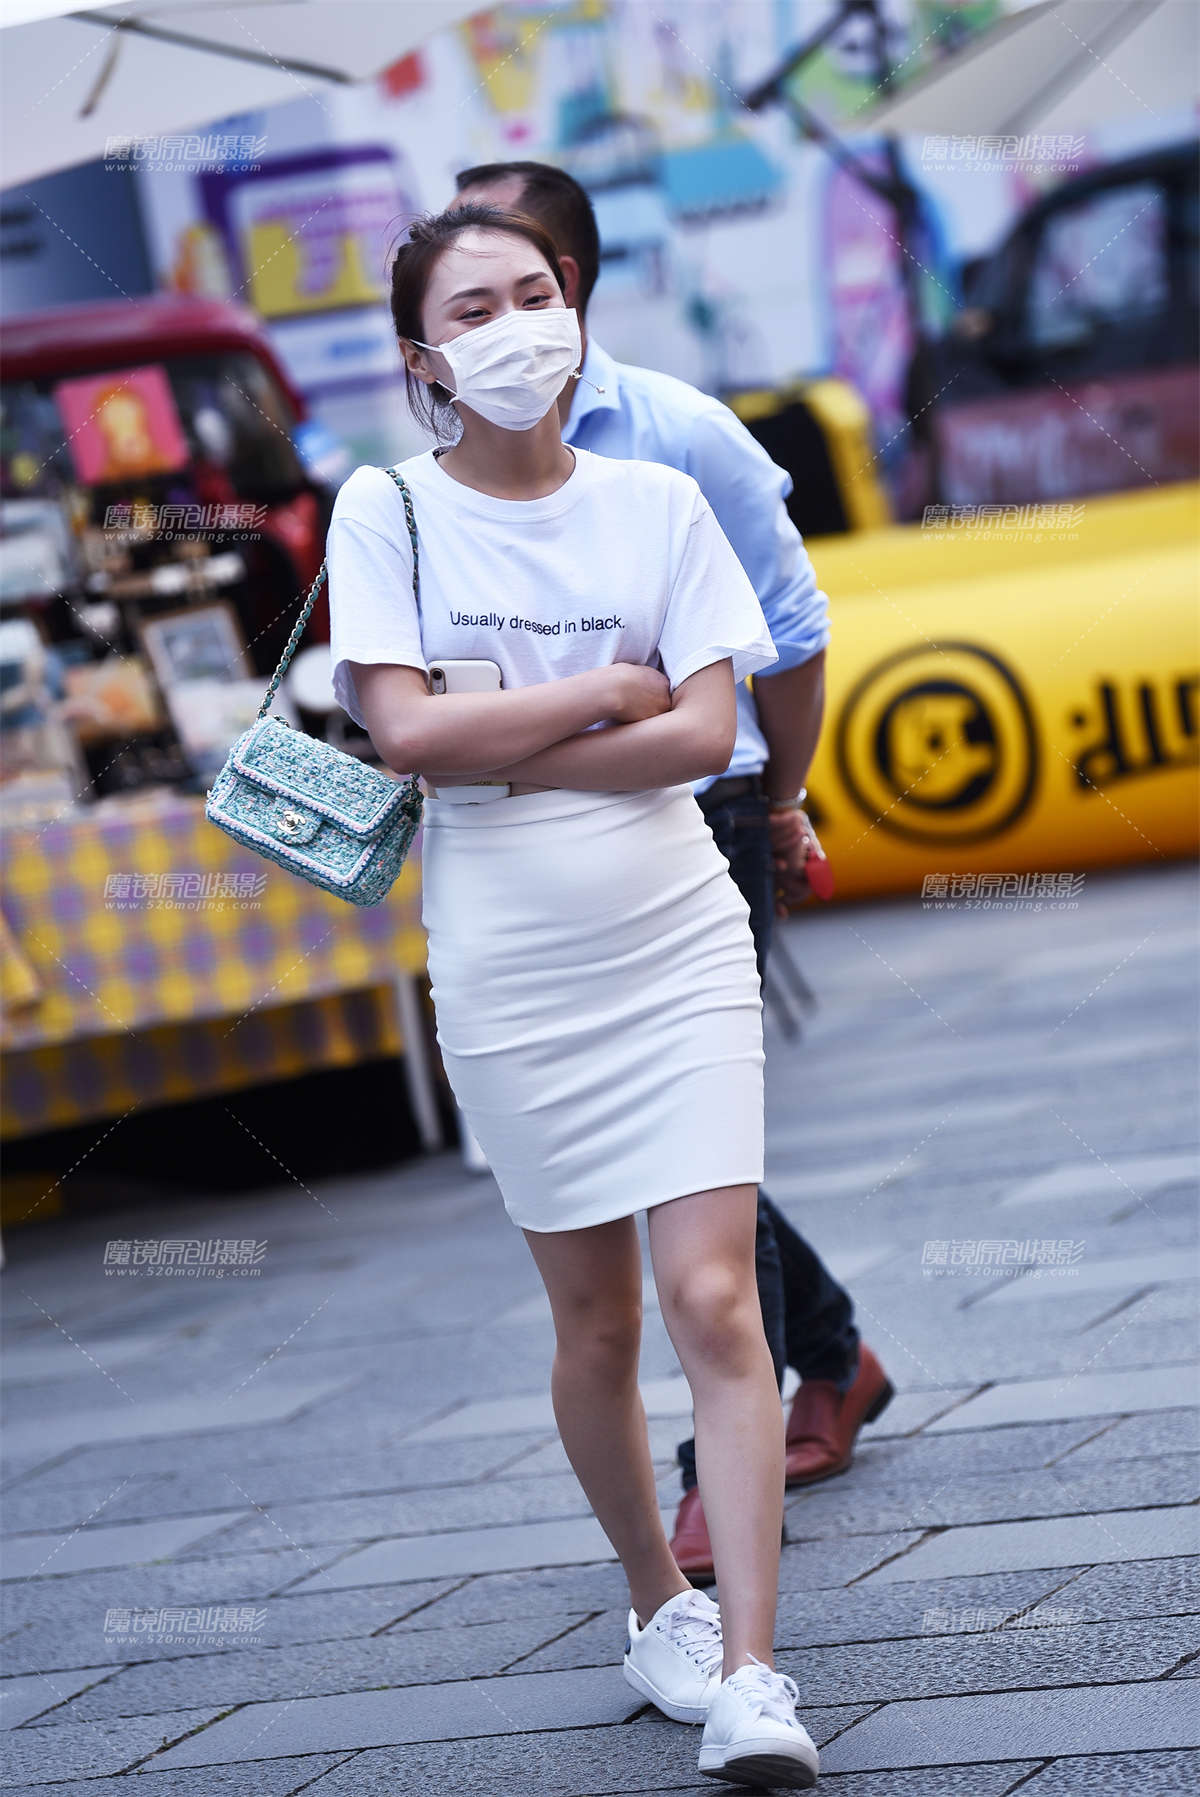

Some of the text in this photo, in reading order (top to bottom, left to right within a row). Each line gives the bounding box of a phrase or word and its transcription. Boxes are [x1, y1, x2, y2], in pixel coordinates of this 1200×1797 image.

[449, 611, 626, 635] Usually dressed in black.
